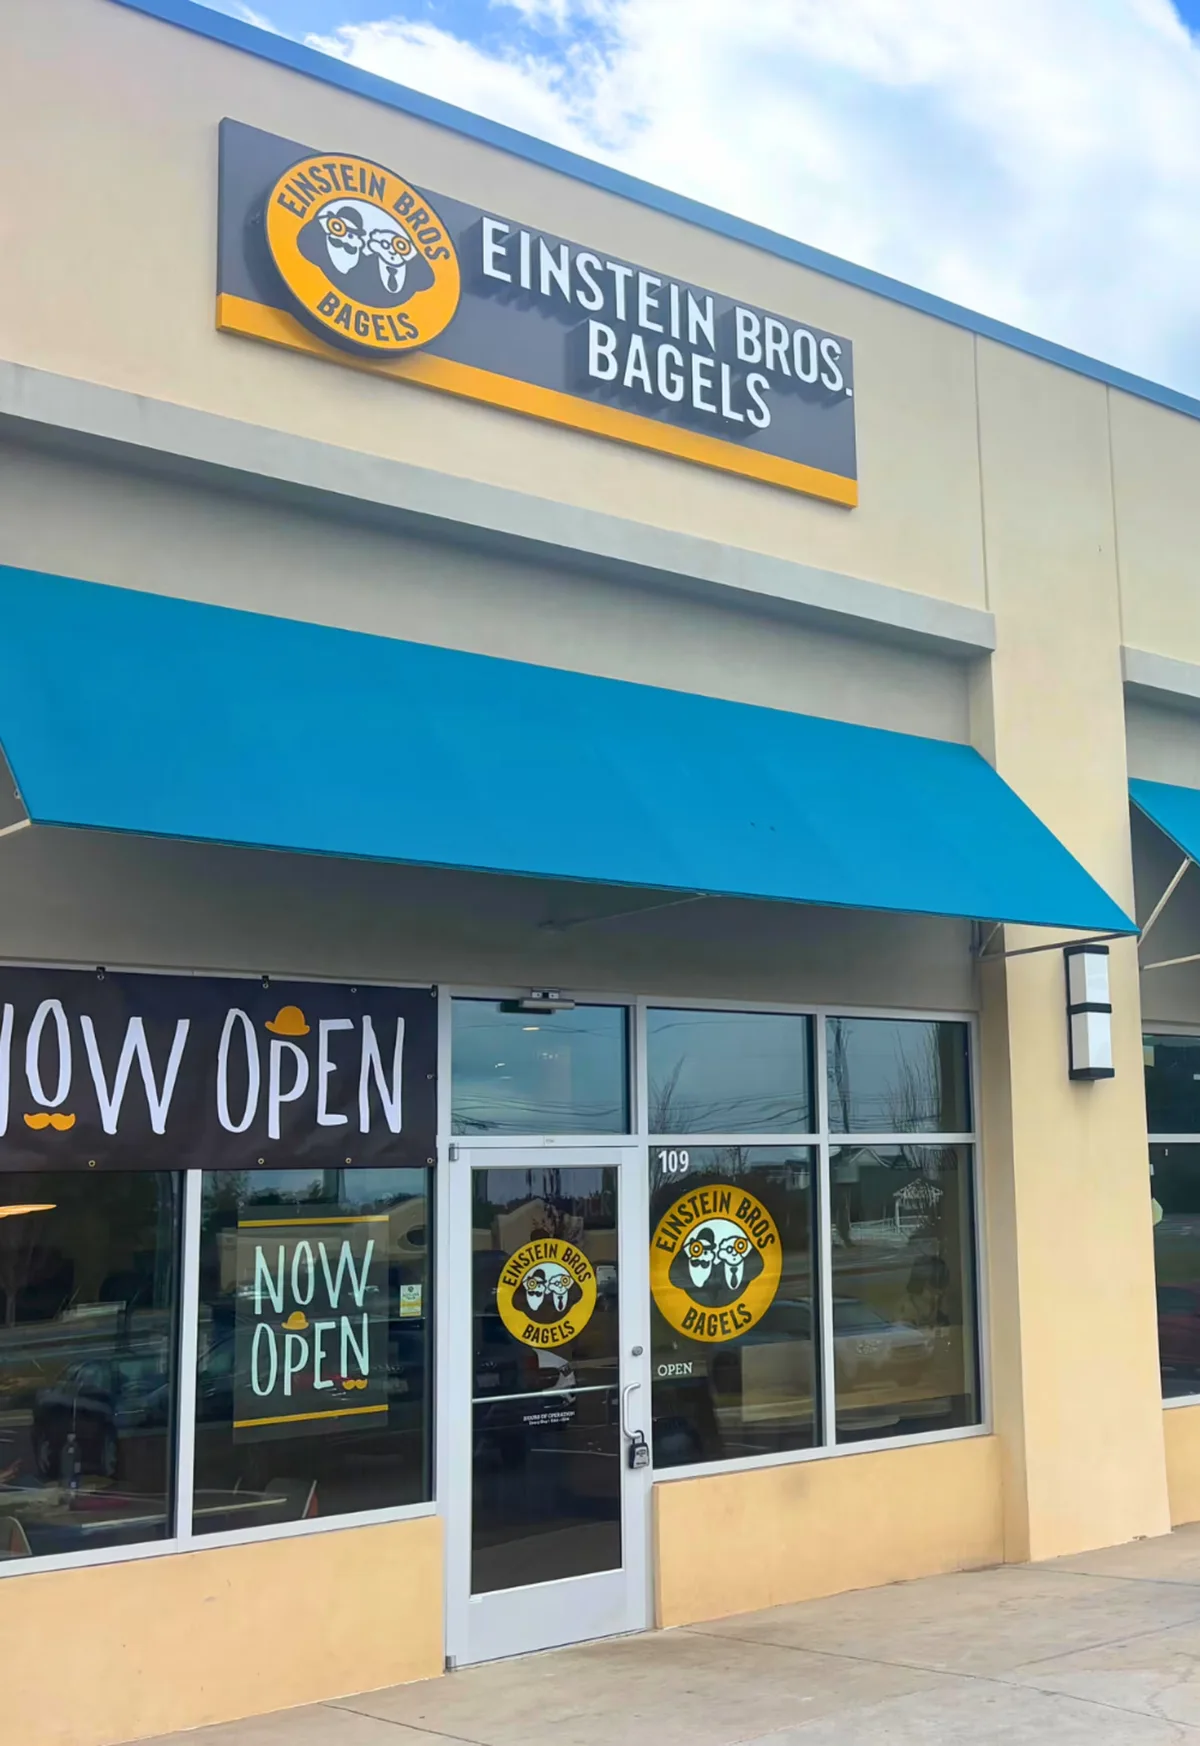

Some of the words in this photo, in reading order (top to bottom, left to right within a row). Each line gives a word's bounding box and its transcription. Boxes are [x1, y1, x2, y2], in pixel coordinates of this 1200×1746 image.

[276, 163, 386, 219] EINSTEIN
[392, 190, 451, 262] BROS
[316, 291, 419, 342] BAGELS
[481, 216, 716, 352] EINSTEIN
[736, 305, 853, 397] BROS.
[588, 319, 771, 430] BAGELS
[216, 1007, 406, 1140] OPEN
[658, 1150, 689, 1173] 109
[655, 1190, 732, 1253] EINSTEIN
[736, 1196, 776, 1250] BROS
[254, 1239, 375, 1315] NOW
[502, 1243, 558, 1287] EINSTEIN
[561, 1247, 591, 1283] BROS
[522, 1320, 575, 1344] BAGELS
[680, 1303, 753, 1337] BAGELS
[251, 1312, 370, 1396] OPEN
[657, 1362, 693, 1377] OPEN
